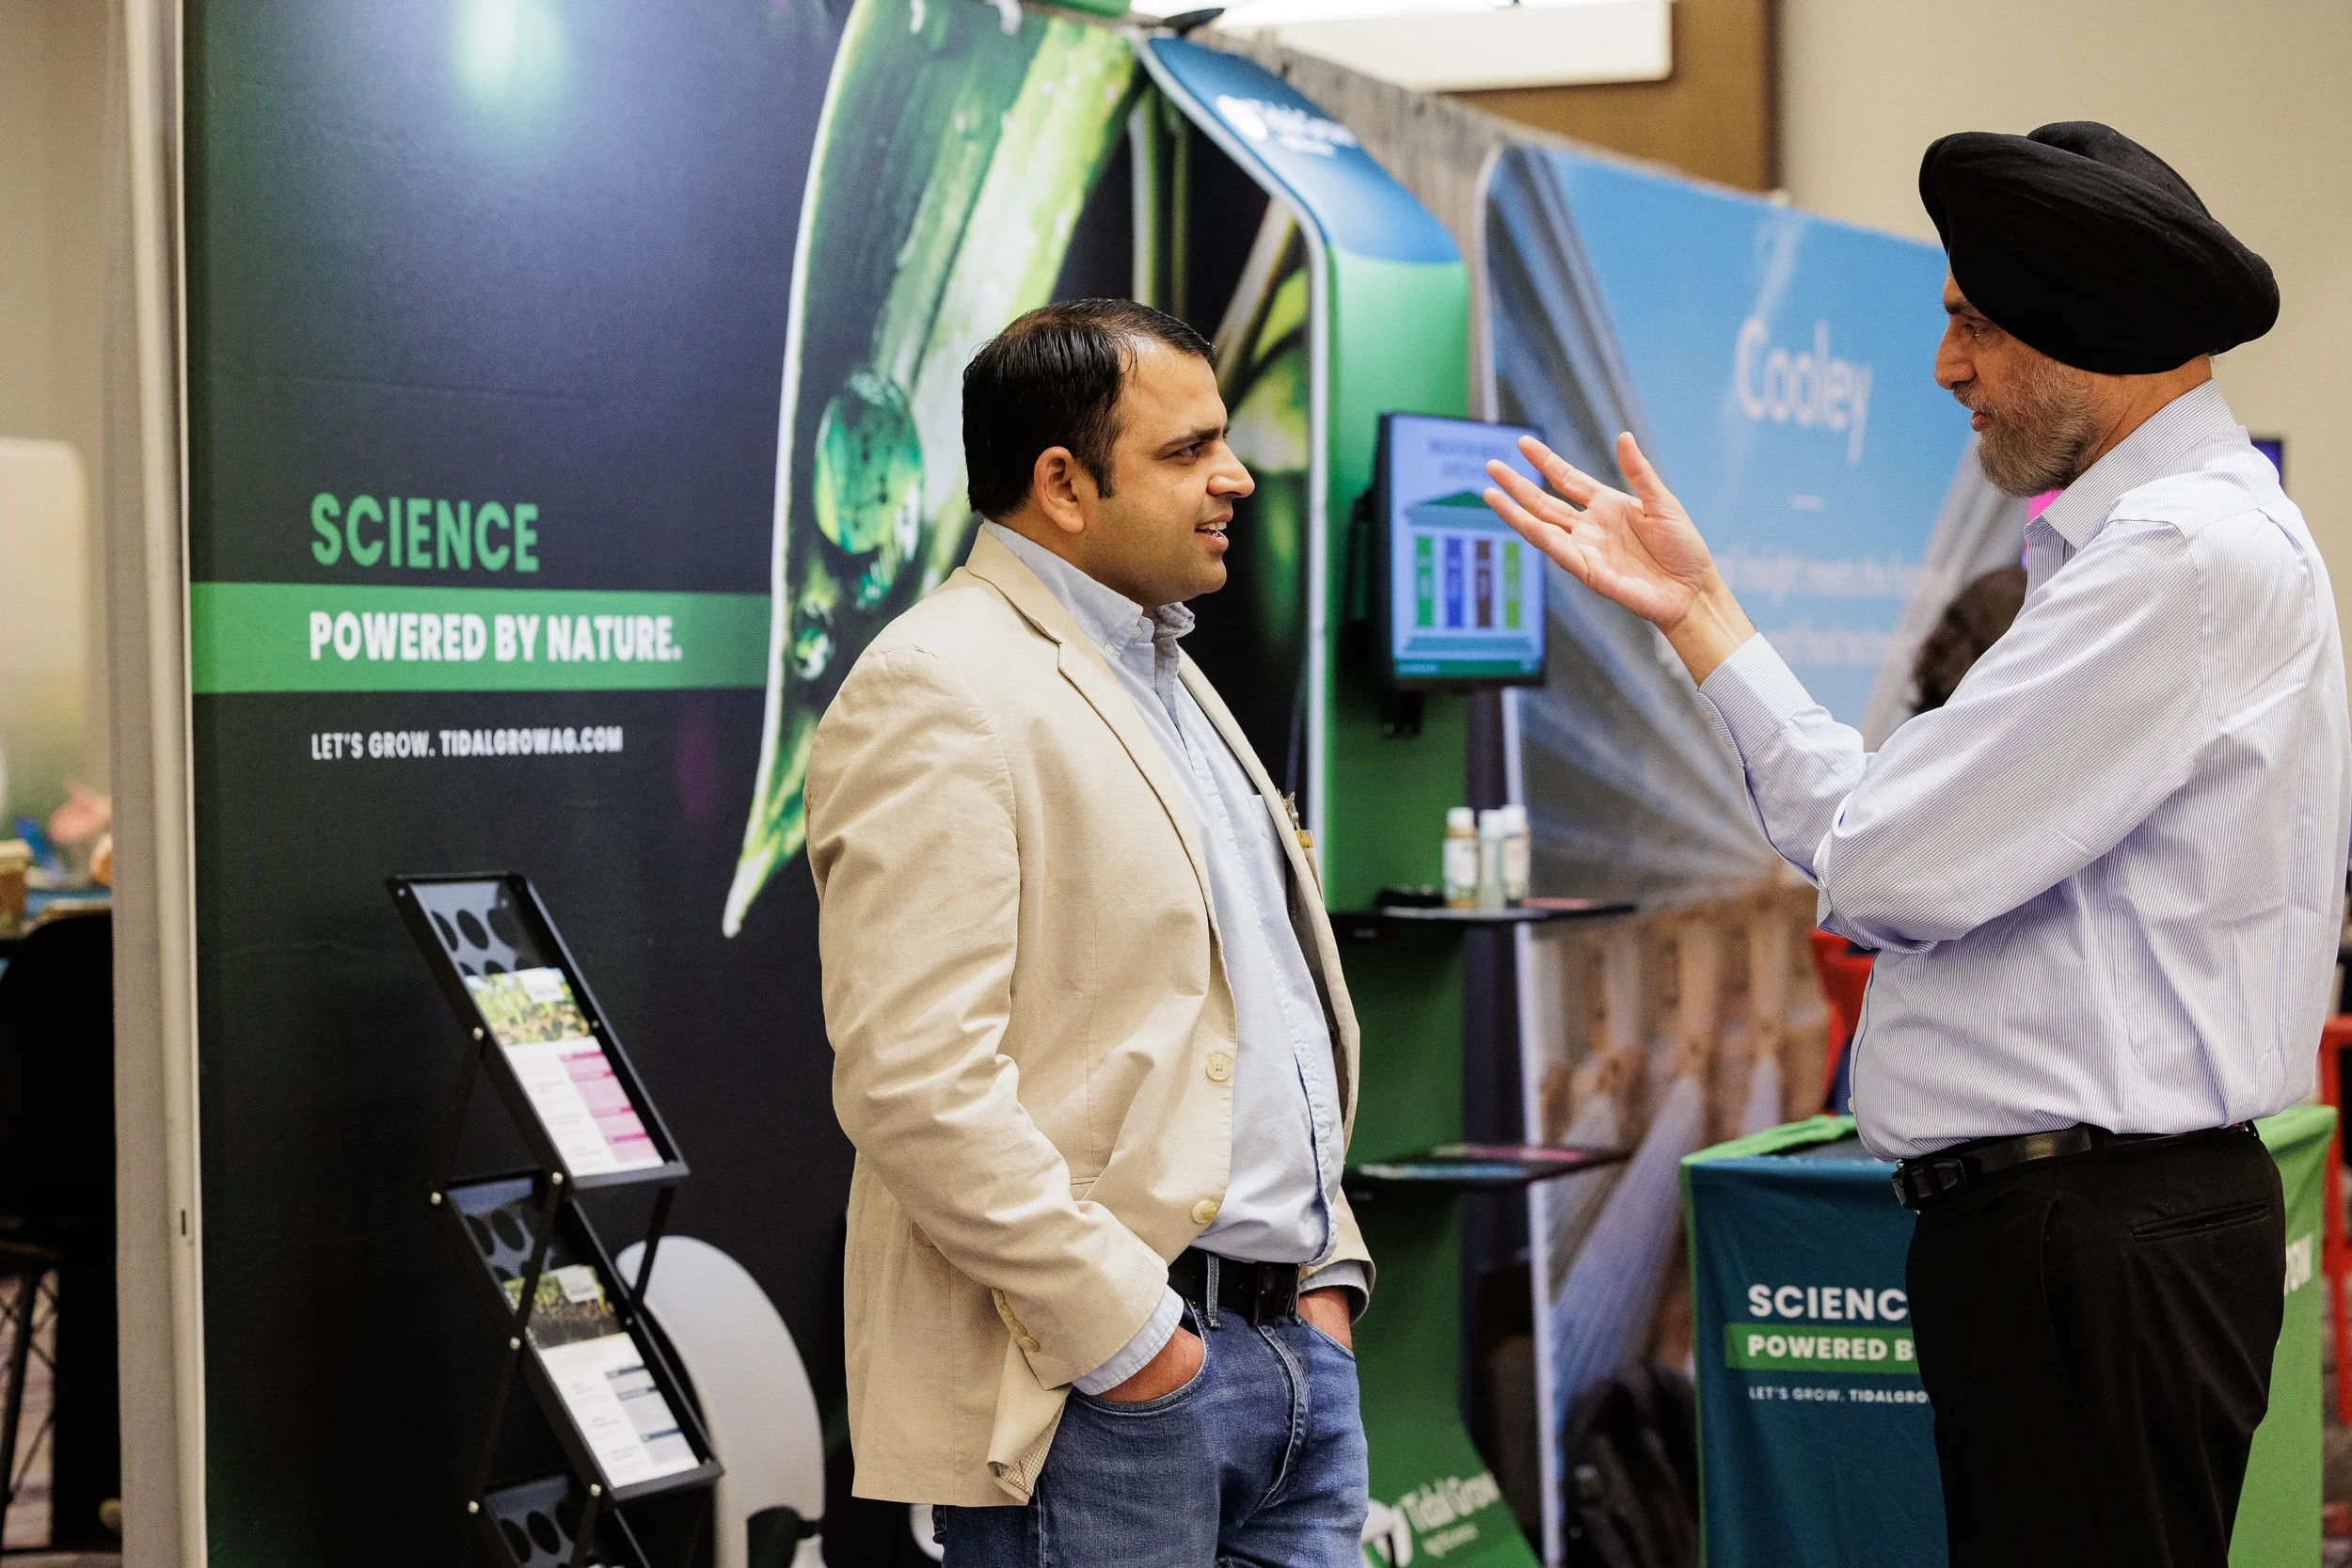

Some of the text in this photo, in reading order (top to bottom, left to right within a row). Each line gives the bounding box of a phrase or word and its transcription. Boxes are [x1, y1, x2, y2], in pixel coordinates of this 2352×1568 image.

[1735, 317, 1872, 465] Cooley
[310, 492, 539, 572] SCIENCE
[310, 610, 682, 661] POWERED BY NATURE.
[311, 726, 623, 760] LET'S GROW. TIDALGROWAG.COM
[1748, 1284, 1909, 1322] SCIENC
[1747, 1334, 1915, 1361] POWERED B
[1748, 1386, 1931, 1403] LET'S GROW. TIDALGRO
